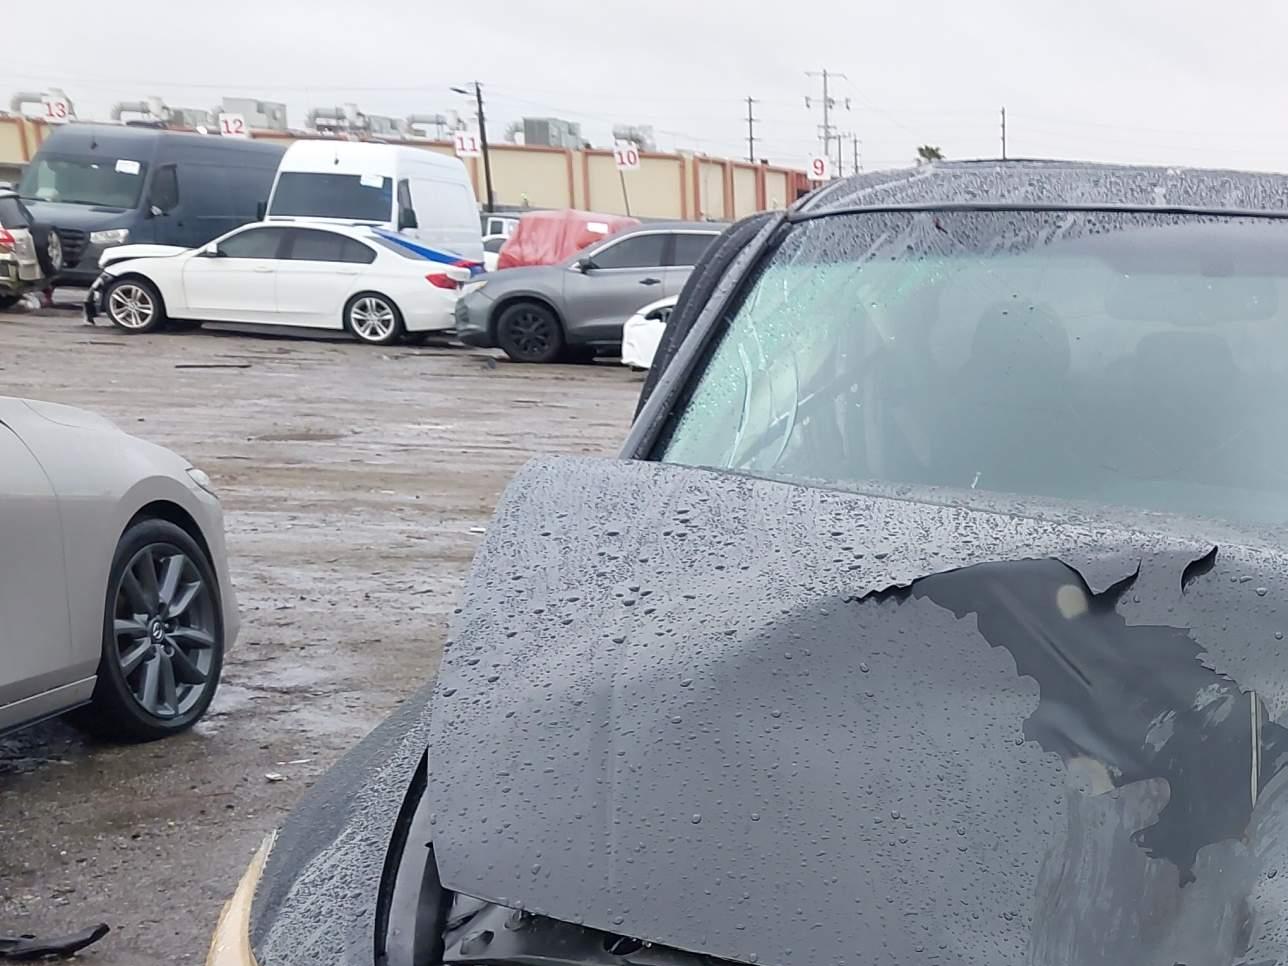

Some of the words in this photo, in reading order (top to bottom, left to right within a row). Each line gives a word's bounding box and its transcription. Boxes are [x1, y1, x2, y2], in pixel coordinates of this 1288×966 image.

[45, 100, 67, 118] 13
[222, 118, 244, 135] 12
[456, 135, 479, 152] 11
[616, 150, 638, 166] 10
[813, 158, 825, 176] 9
